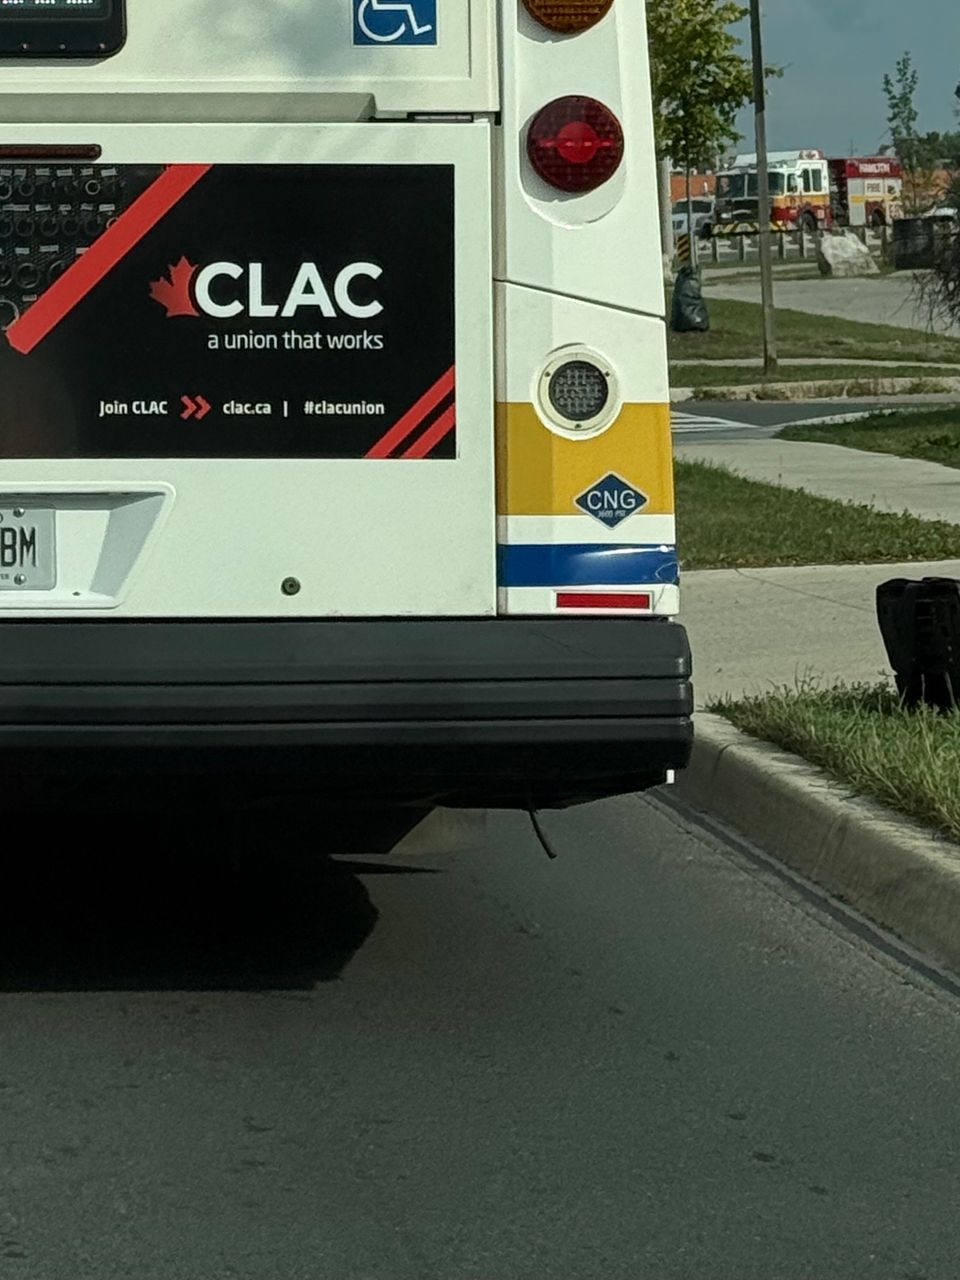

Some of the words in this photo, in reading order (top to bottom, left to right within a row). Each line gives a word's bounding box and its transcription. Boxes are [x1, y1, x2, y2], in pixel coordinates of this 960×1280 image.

[194, 261, 385, 319] CLAC
[207, 334, 219, 349] a
[224, 330, 278, 349] union
[282, 330, 322, 349] that
[327, 330, 384, 349] works
[99, 400, 128, 417] Join
[132, 401, 168, 415] CLAC
[223, 401, 272, 415] clac.ca
[303, 401, 385, 415] #clacunion
[587, 489, 636, 510] CNG
